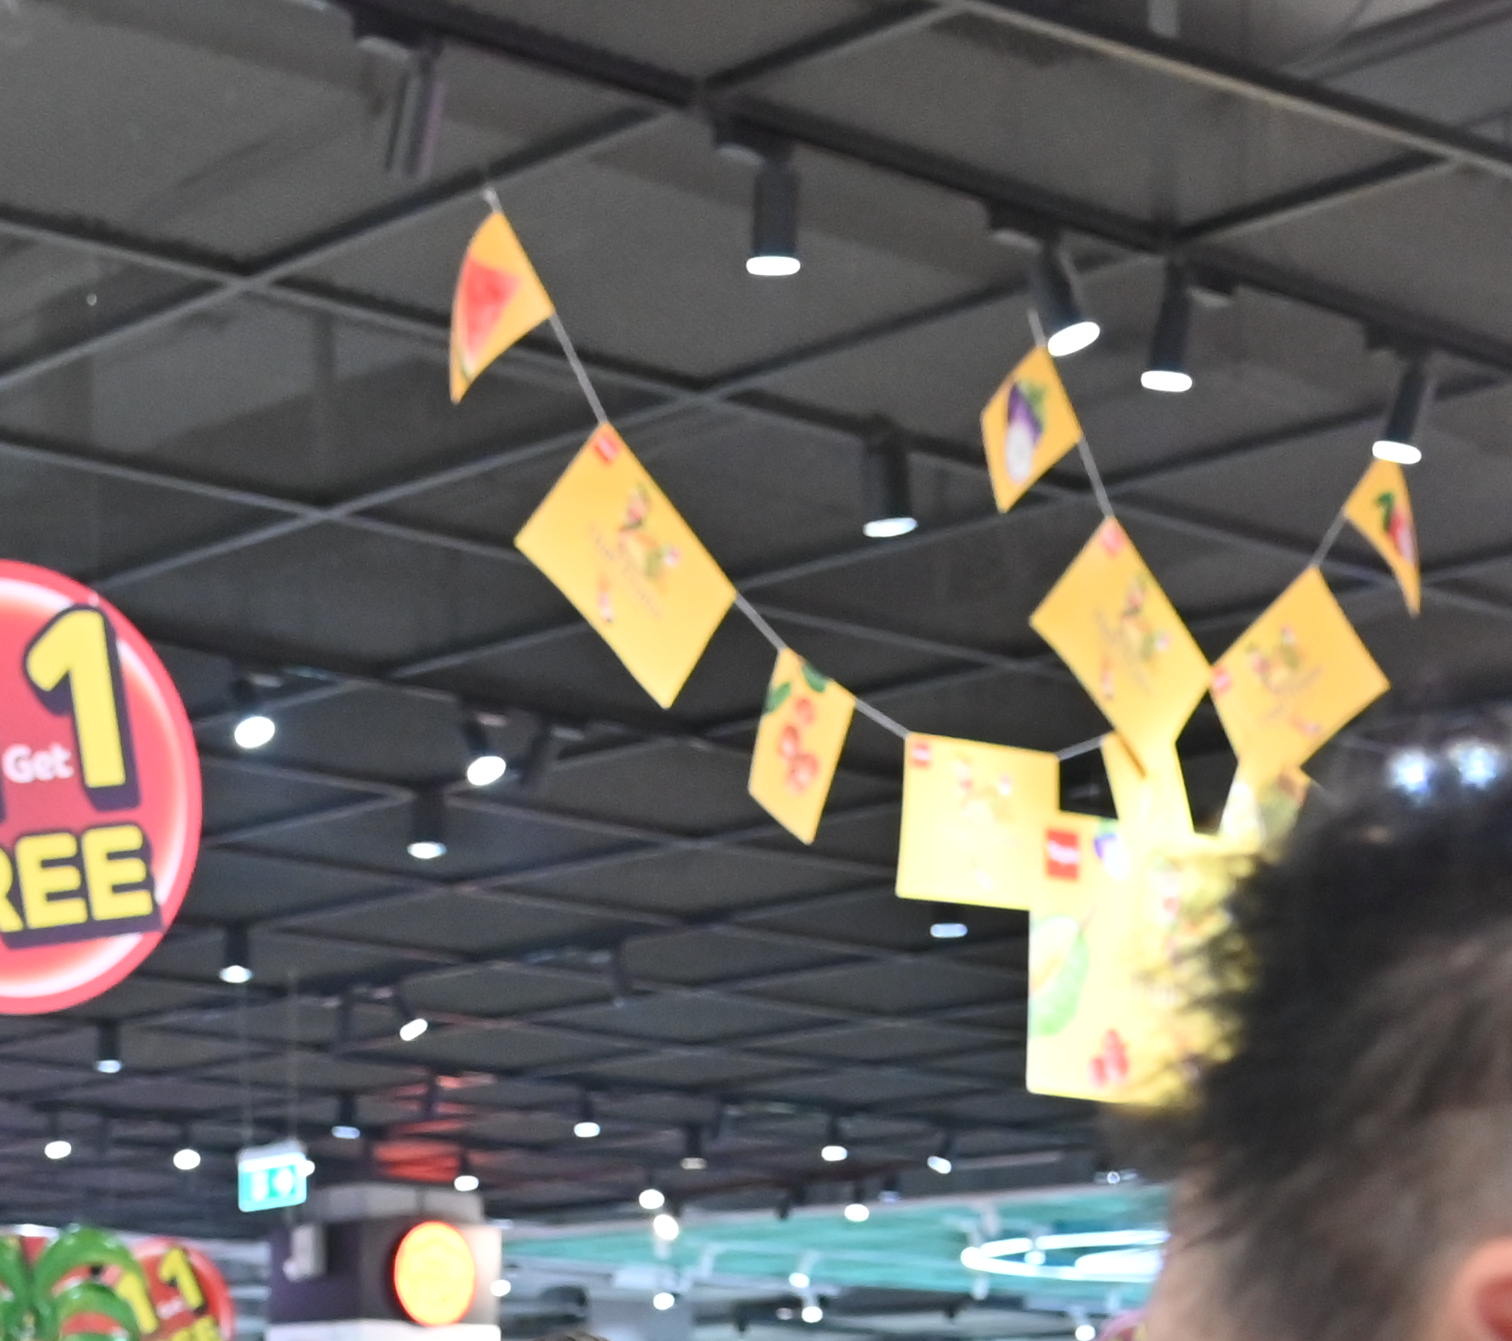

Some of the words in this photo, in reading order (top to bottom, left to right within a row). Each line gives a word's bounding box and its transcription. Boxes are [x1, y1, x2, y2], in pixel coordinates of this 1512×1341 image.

[24, 607, 127, 789] 1
[2, 741, 74, 784] Get
[157, 1246, 206, 1310] 1
